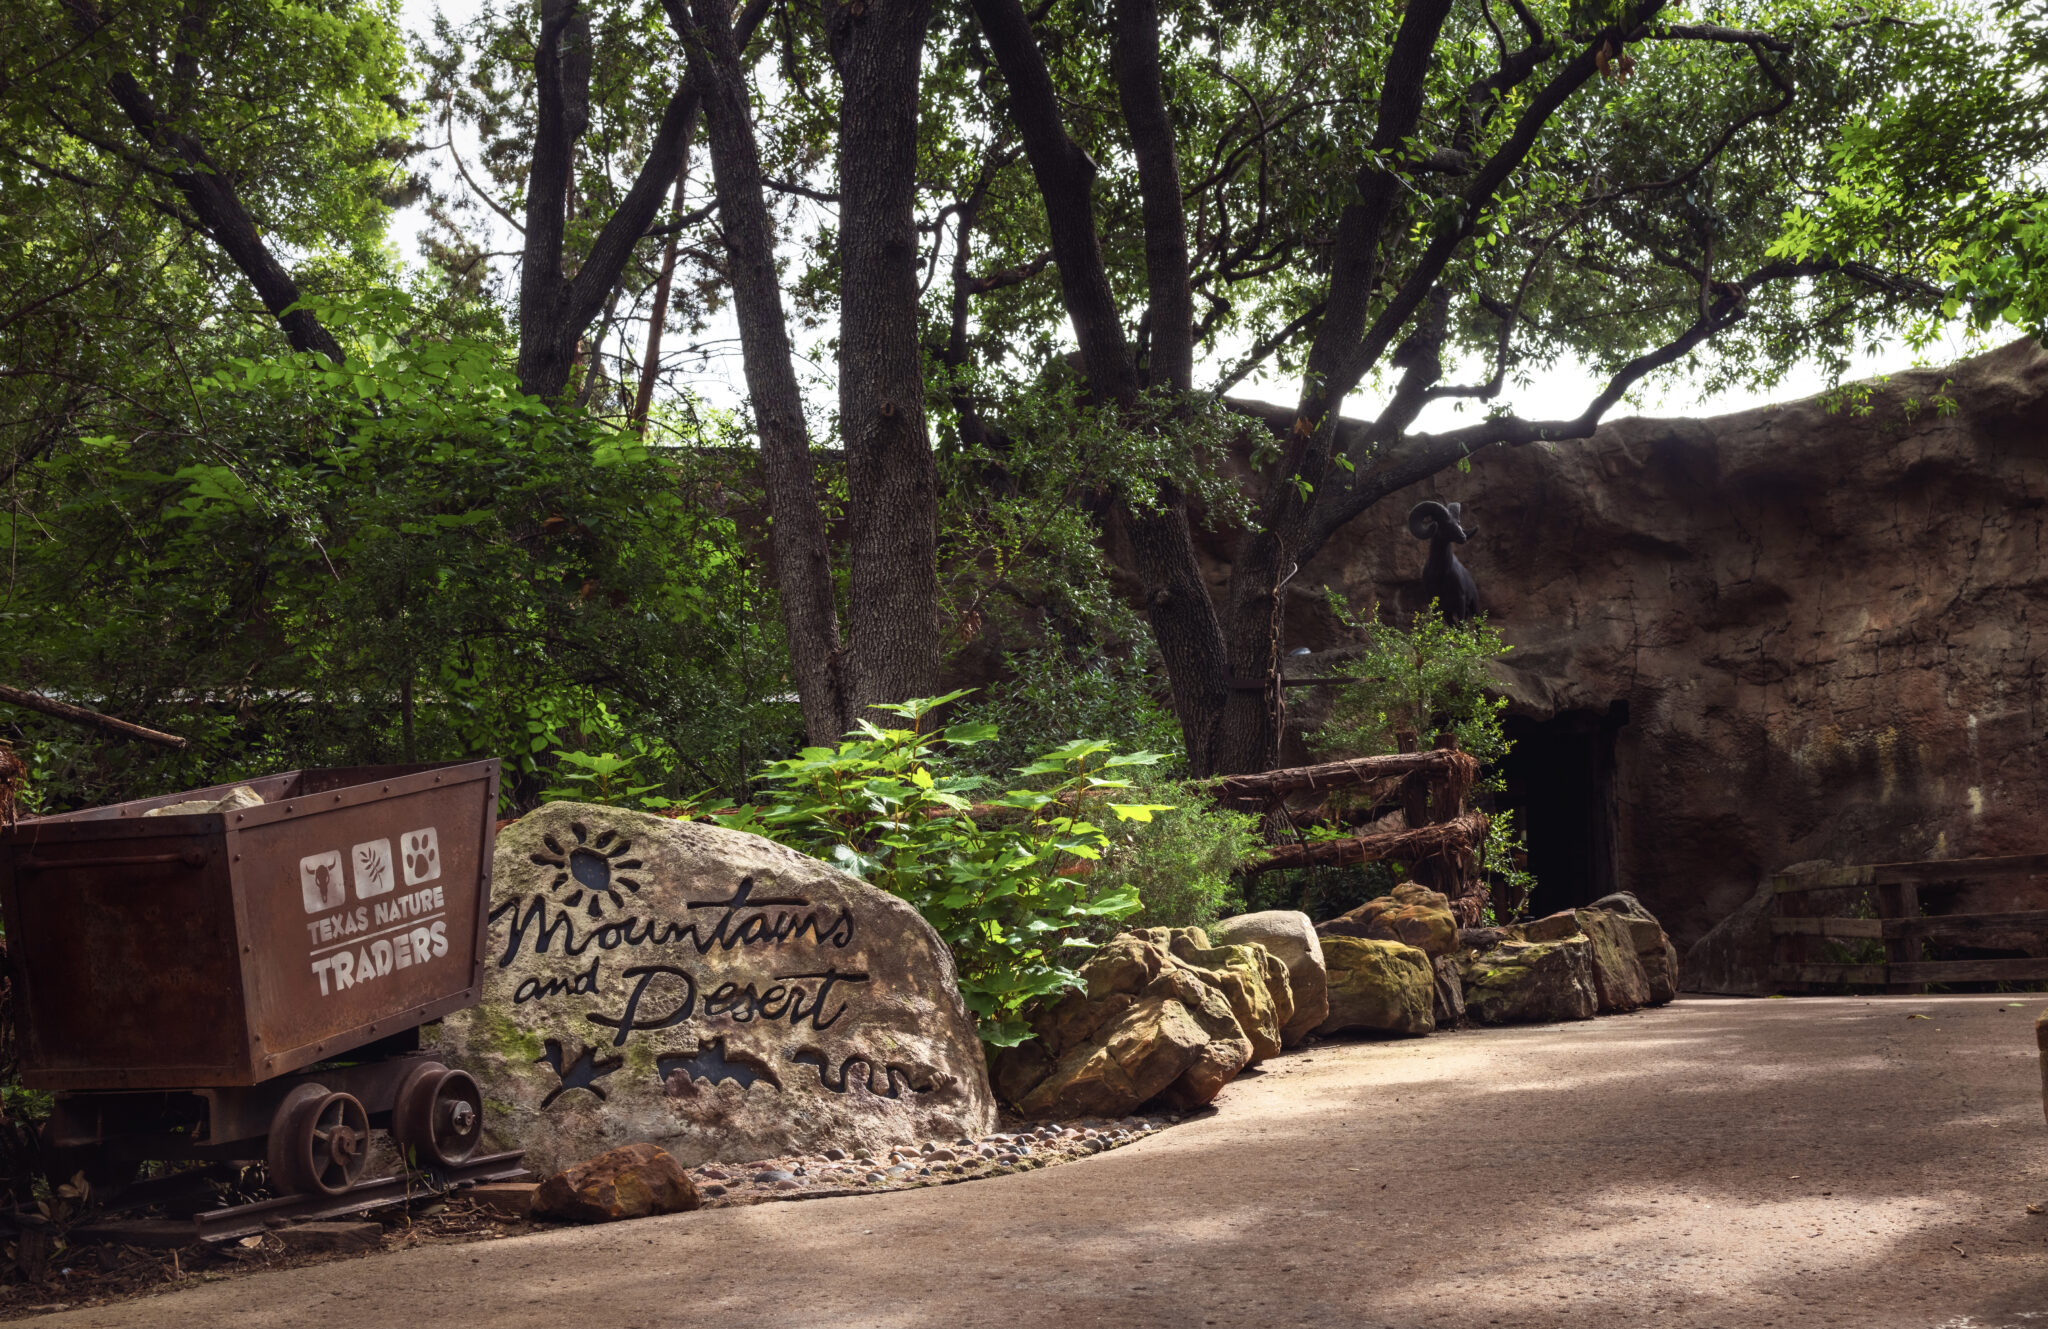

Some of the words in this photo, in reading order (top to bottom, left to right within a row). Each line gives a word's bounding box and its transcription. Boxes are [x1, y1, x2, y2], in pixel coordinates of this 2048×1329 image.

[307, 906, 369, 945] TEXAS
[374, 886, 445, 926] NATURE
[488, 877, 854, 968] Mountains
[312, 920, 449, 996] TRADERS
[513, 957, 601, 1004] and
[586, 965, 870, 1047] Desert
